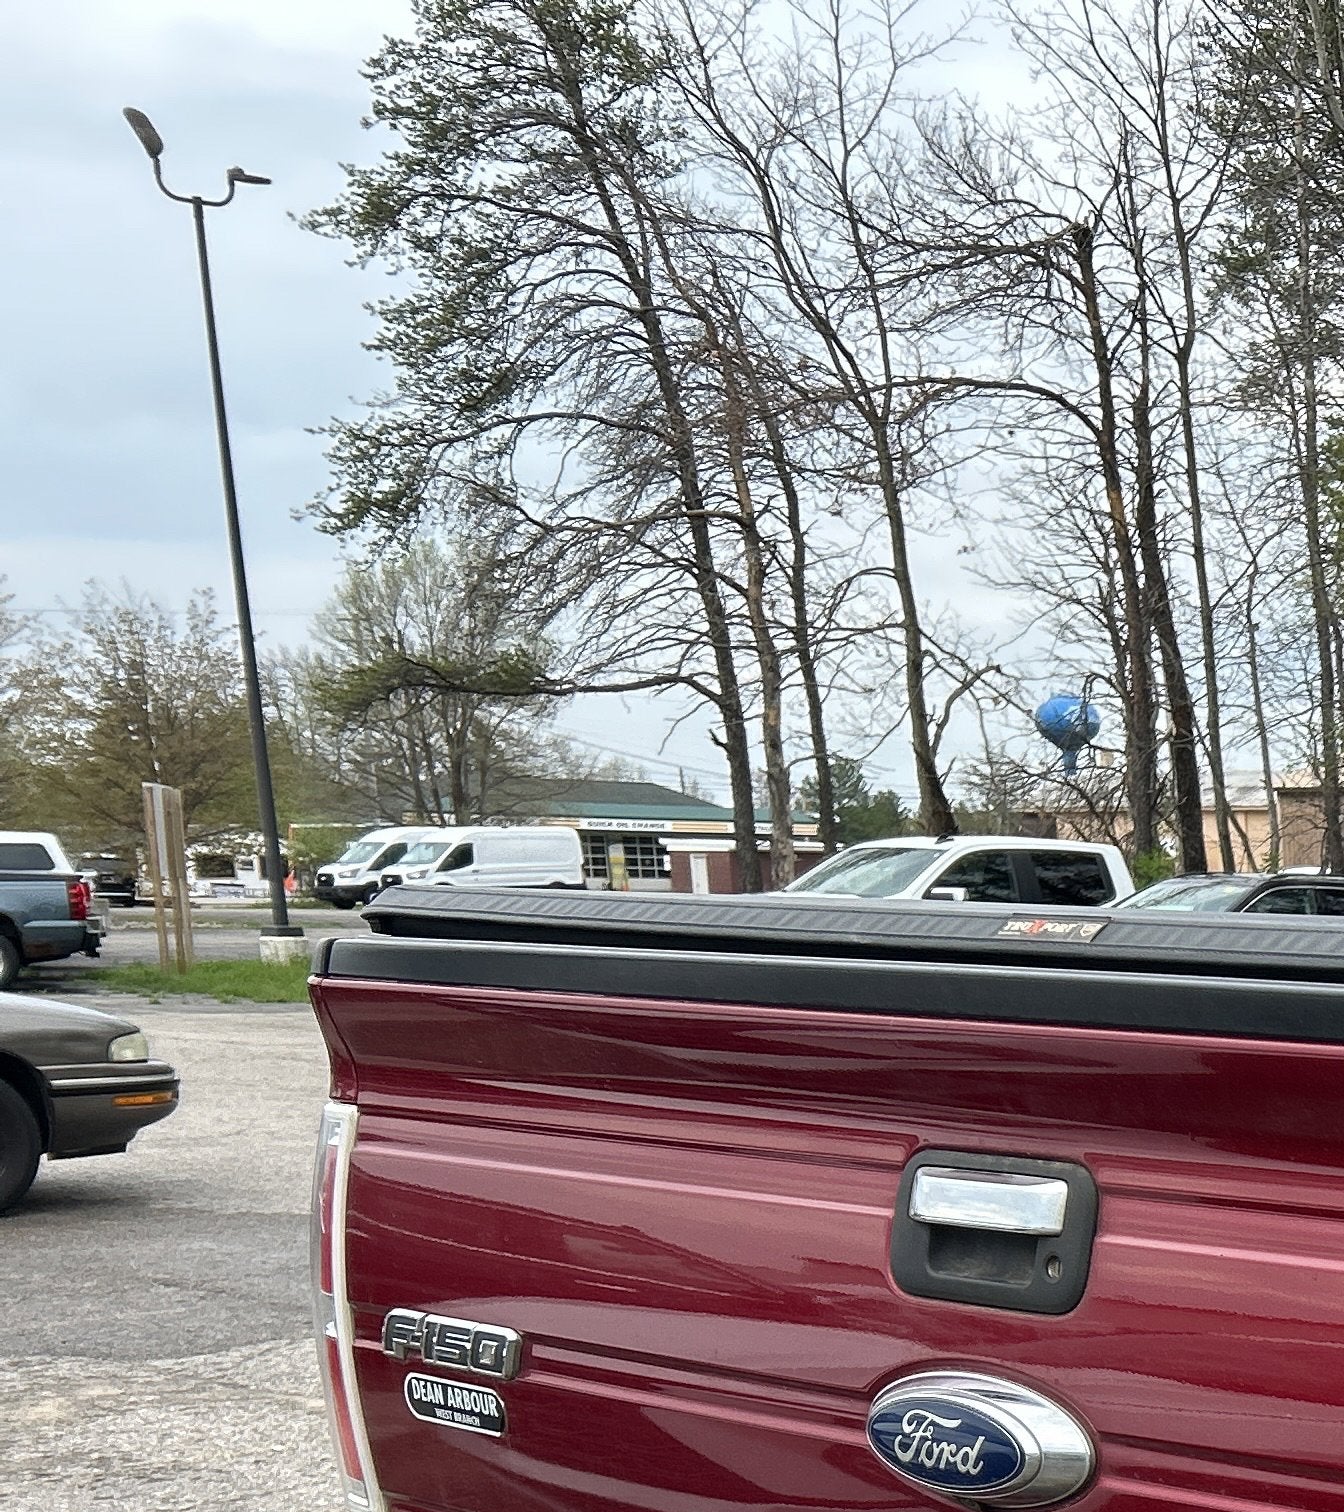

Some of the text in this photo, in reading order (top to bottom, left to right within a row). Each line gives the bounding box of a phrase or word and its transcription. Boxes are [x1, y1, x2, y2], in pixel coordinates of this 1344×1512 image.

[383, 1308, 522, 1380] F-150
[411, 1378, 499, 1418] DEAN ARBOUR
[434, 1407, 453, 1421] WEST
[894, 1408, 986, 1476] Ford
